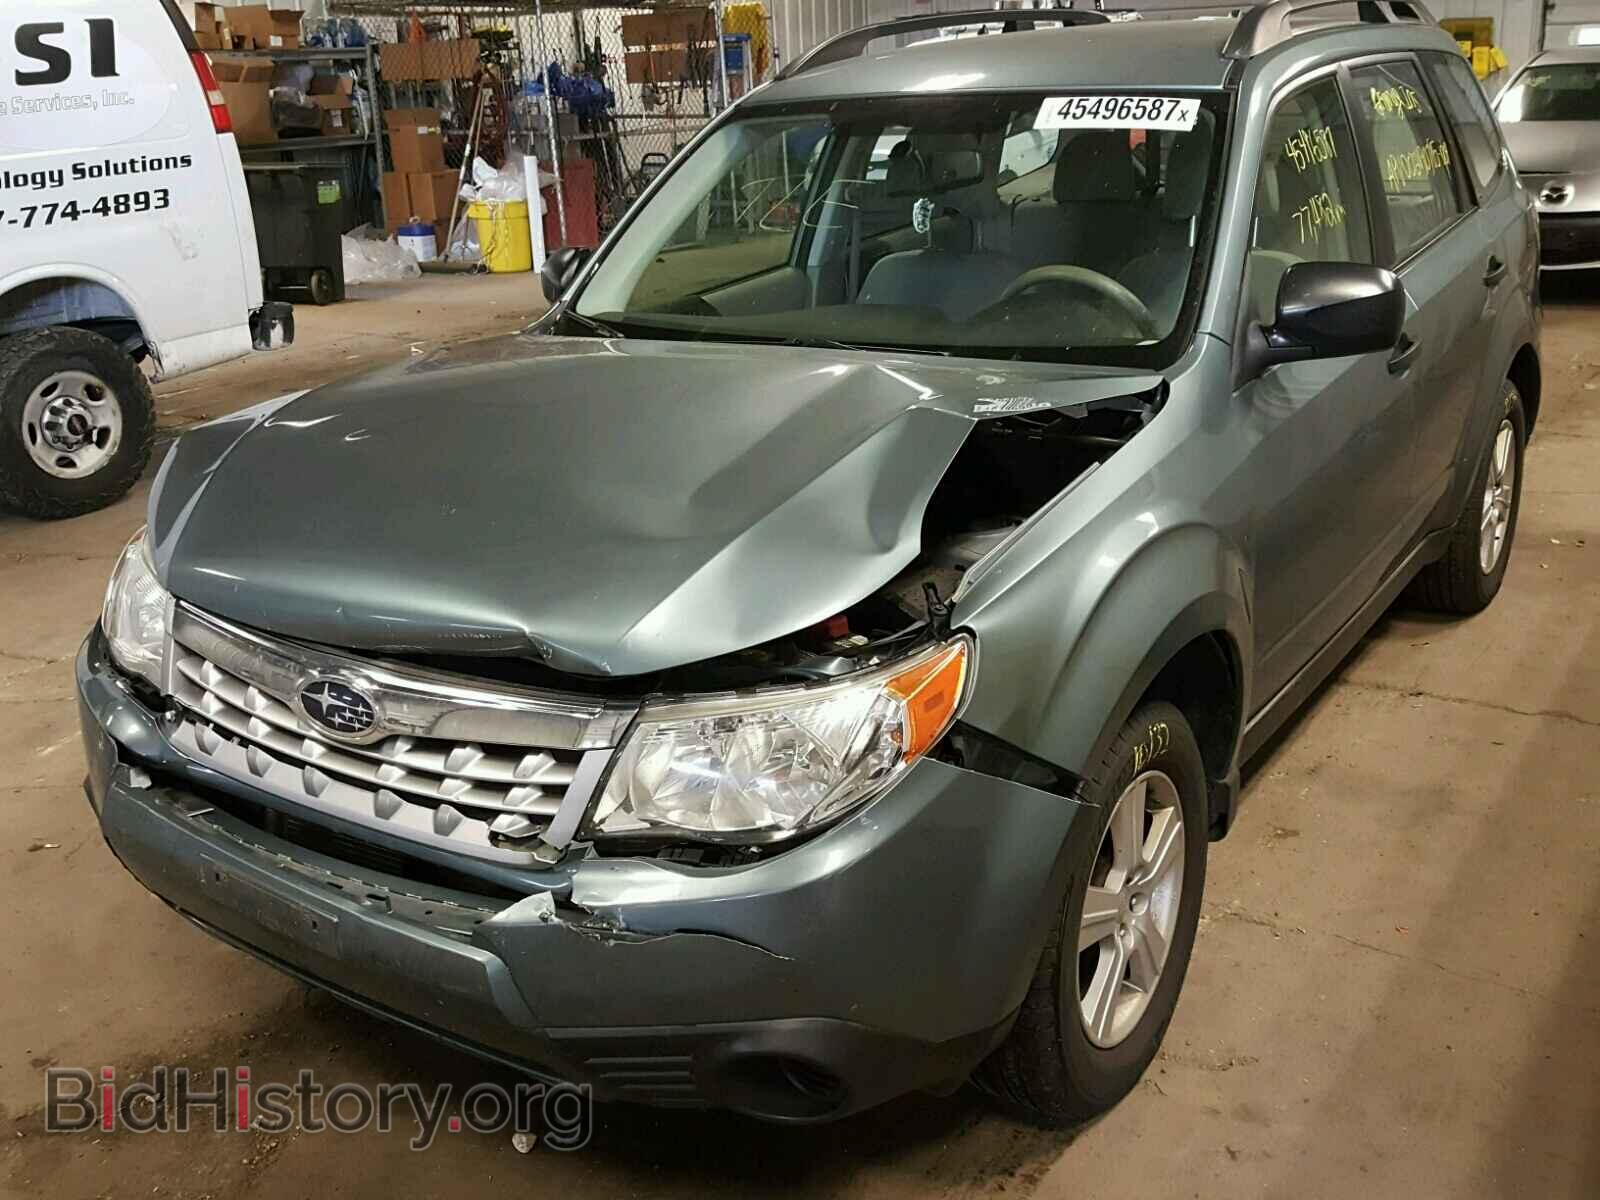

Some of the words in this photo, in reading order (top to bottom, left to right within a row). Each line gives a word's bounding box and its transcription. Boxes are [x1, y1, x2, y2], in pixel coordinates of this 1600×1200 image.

[11, 92, 98, 115] Services,
[102, 89, 135, 107] Inc.
[0, 169, 64, 190] logy
[71, 155, 192, 180] Solutions
